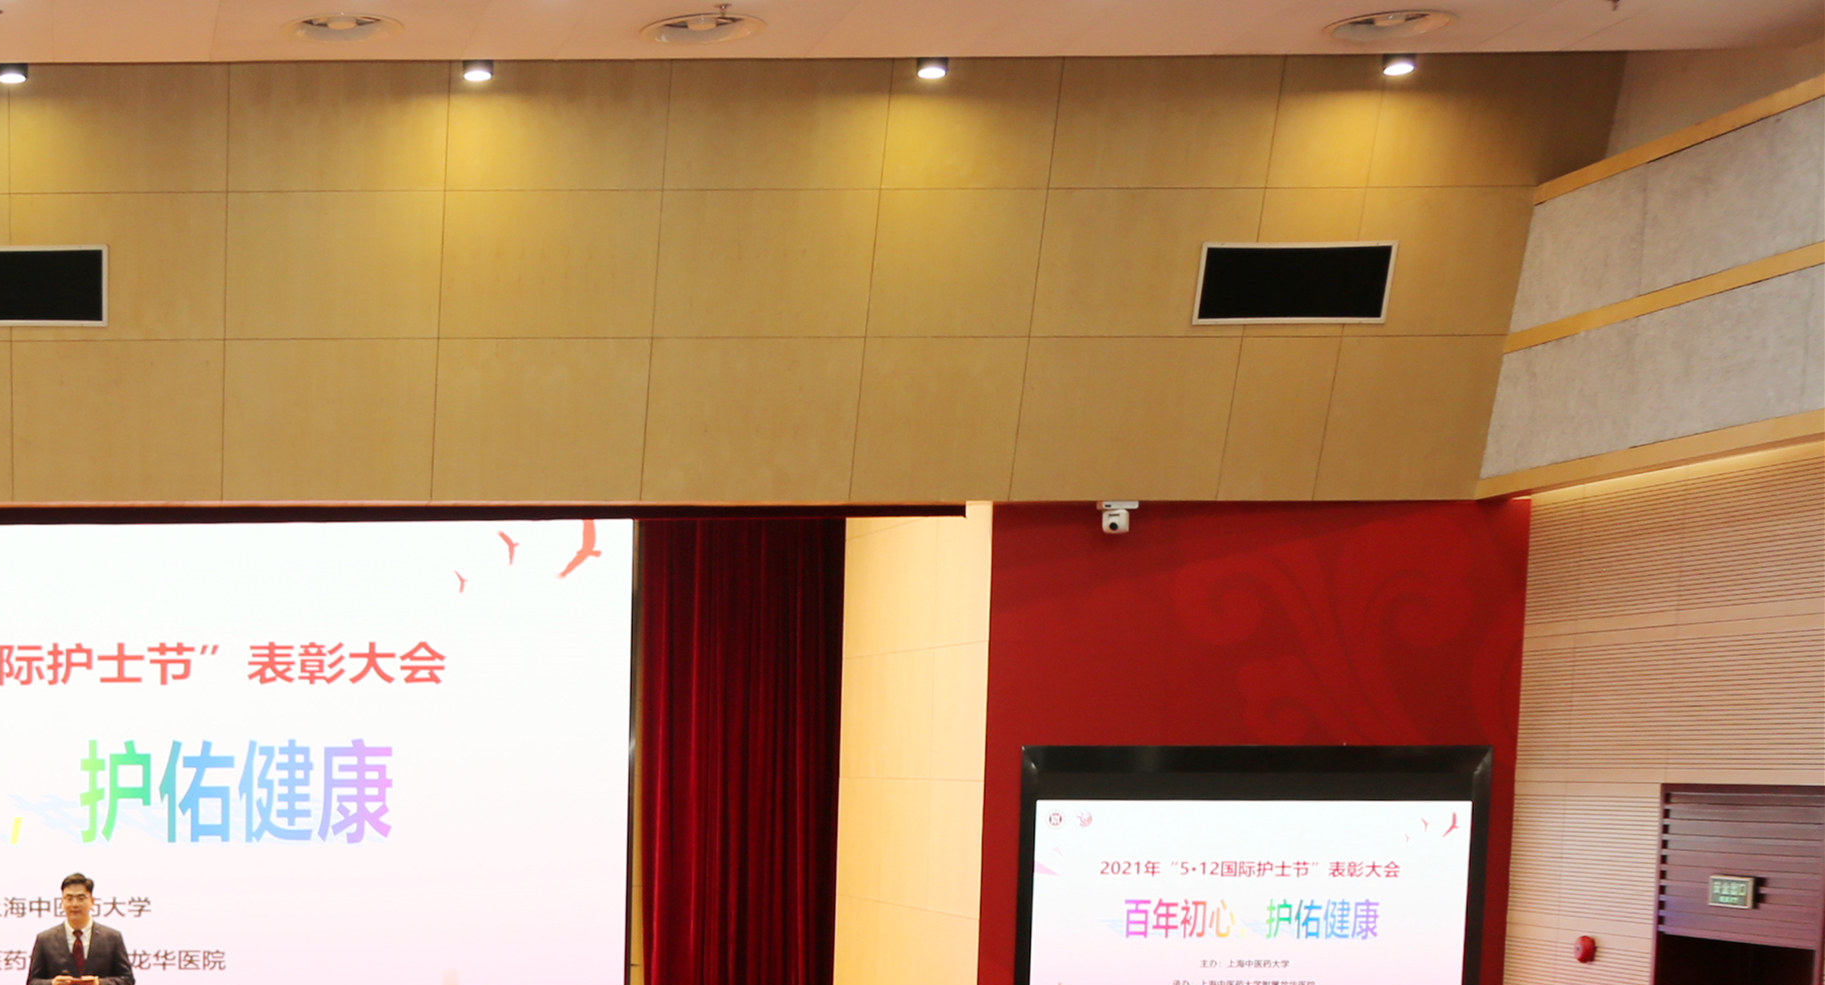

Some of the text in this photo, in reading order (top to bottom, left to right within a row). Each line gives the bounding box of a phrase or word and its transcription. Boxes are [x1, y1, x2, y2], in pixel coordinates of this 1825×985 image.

[1124, 898, 1380, 940] 百年初心，护佑健康
